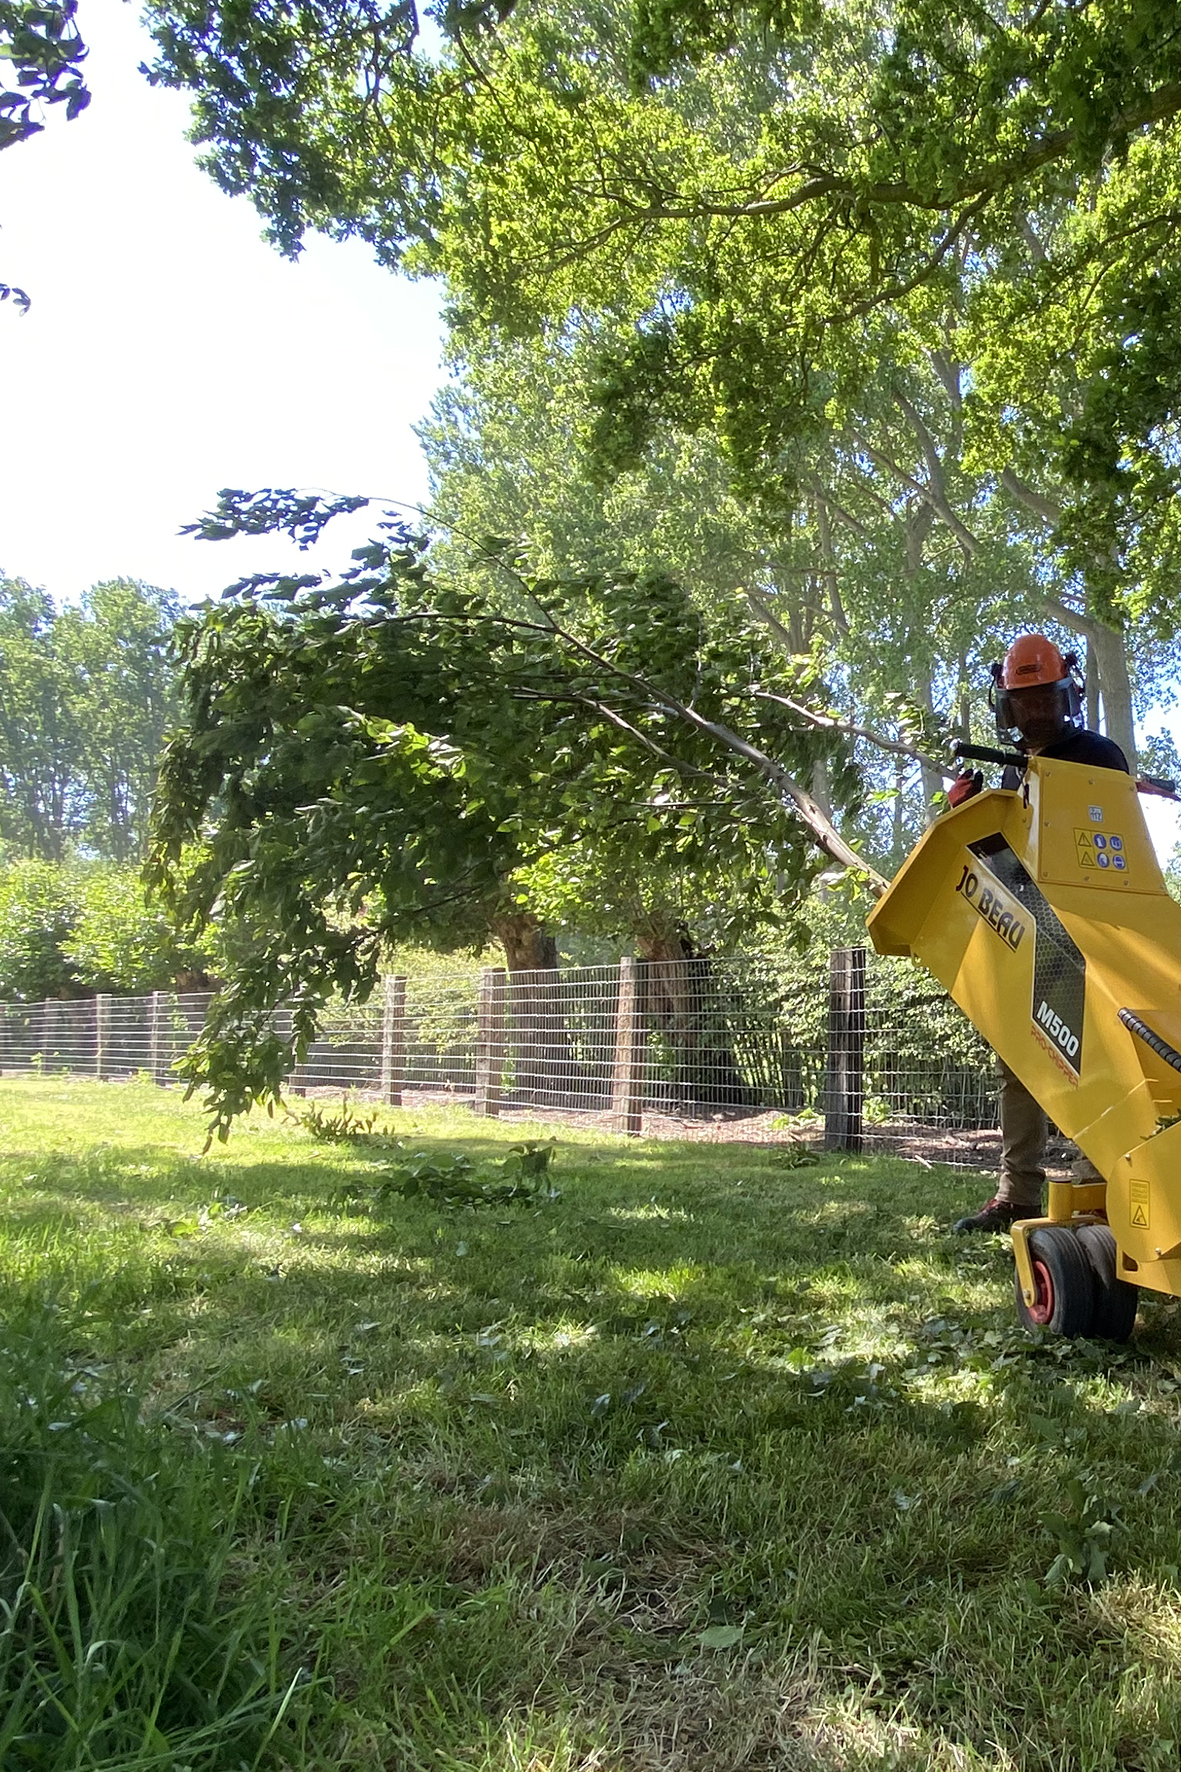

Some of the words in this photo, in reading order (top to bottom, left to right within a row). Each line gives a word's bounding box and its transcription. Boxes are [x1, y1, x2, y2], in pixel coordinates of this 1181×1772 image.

[956, 865, 978, 898] JO
[978, 888, 1025, 950] BEAU
[1036, 1000, 1079, 1057] M500
